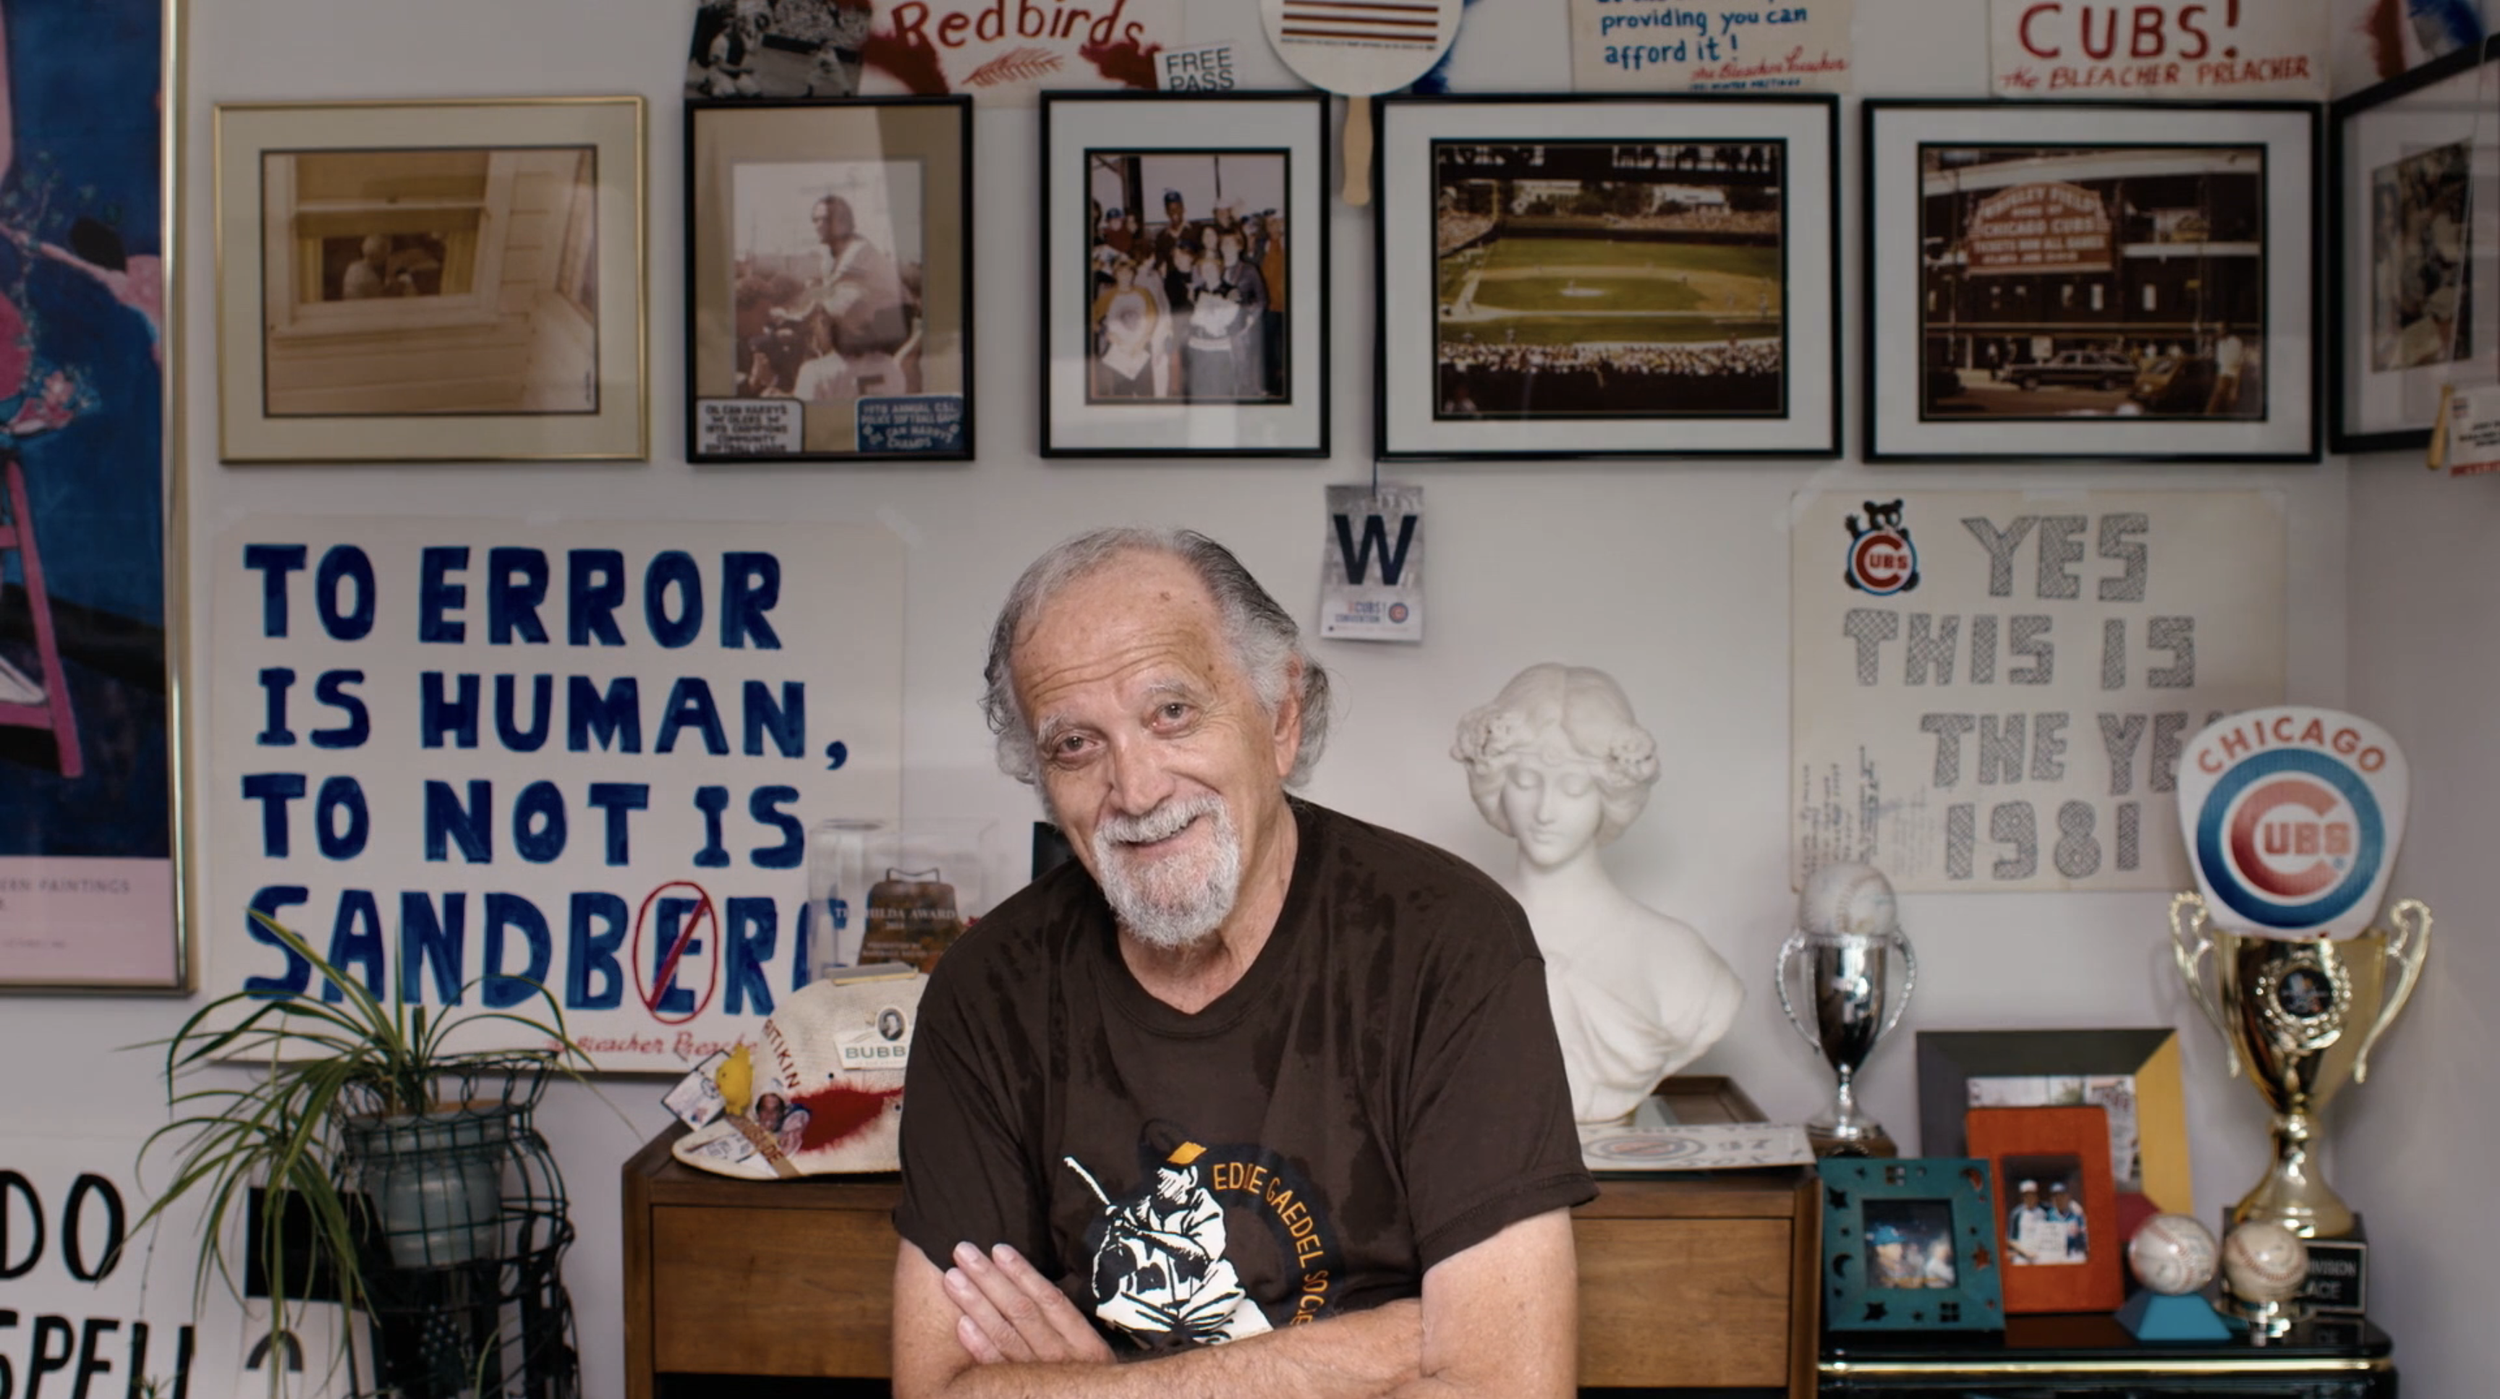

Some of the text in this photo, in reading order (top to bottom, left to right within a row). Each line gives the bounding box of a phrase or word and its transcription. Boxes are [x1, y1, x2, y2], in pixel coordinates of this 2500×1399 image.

[889, 0, 1145, 49] Redbirds
[1602, 7, 1807, 36] providing you can
[1605, 40, 1686, 70] afford
[2018, 0, 2240, 60] CUBS!
[1166, 48, 1233, 74] FREE
[1169, 69, 1235, 91] PASS
[2048, 63, 2180, 89] BLEACHER
[2198, 55, 2311, 85] PREACHER
[1333, 514, 1418, 585] W
[1961, 513, 2149, 602] YES
[244, 544, 783, 650] TO ERROR
[1844, 608, 2196, 690] THIS IS
[257, 667, 848, 770] IS HUMAN,
[1921, 711, 2225, 796] THE YE
[2197, 716, 2386, 774] CHICAGO
[242, 773, 805, 869] TO NOT IS
[1947, 800, 2141, 882] 1981
[2231, 779, 2352, 897] CUBS
[845, 1045, 906, 1060] BUBB
[0, 1170, 125, 1282] DO
[1266, 1178, 1325, 1269] GAEDEL
[2310, 1259, 2358, 1278] IVISION
